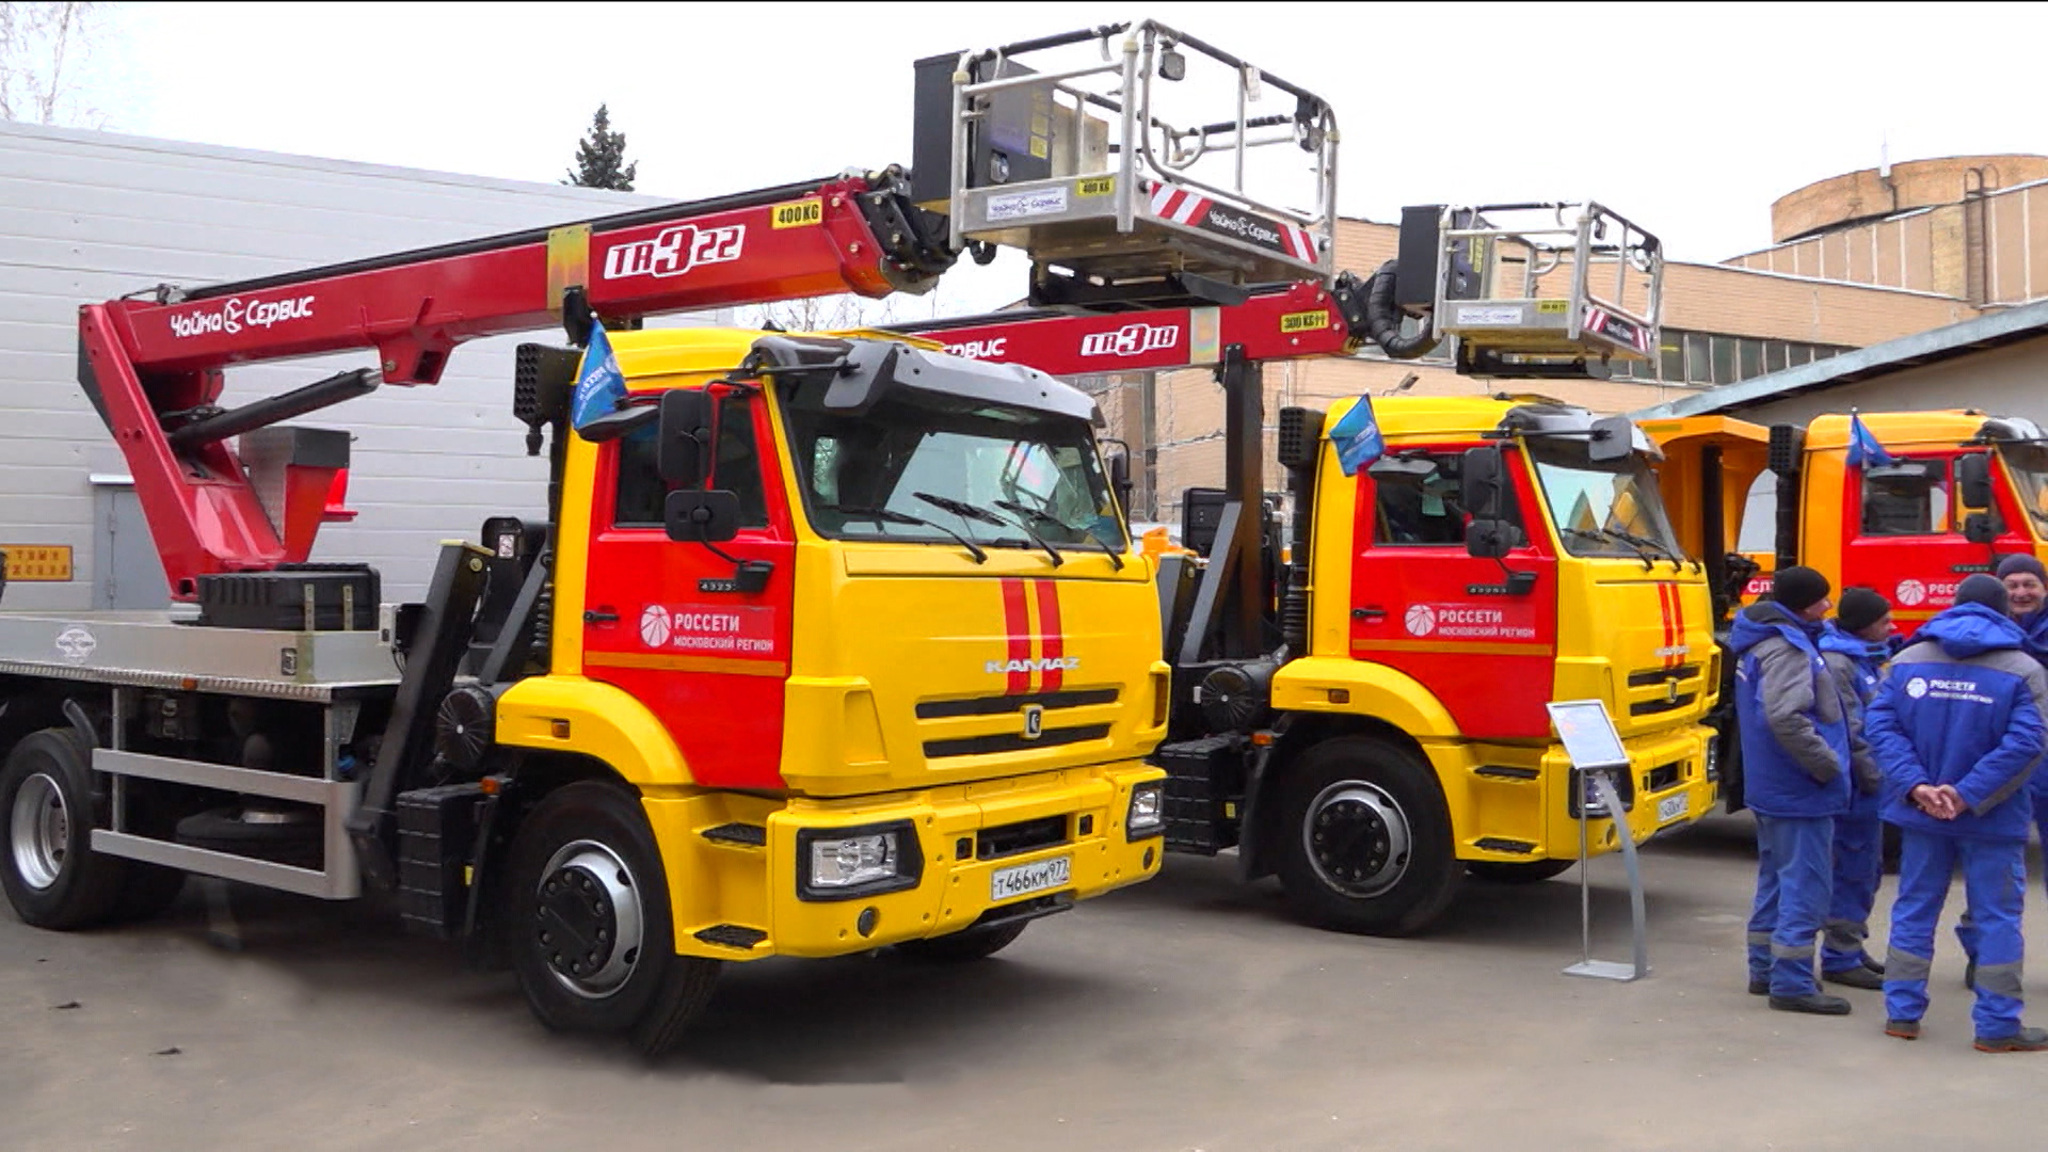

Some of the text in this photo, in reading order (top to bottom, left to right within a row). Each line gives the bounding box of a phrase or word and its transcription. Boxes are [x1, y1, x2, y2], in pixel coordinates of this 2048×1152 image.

[674, 613, 740, 632] РОССЕТИ
[1439, 610, 1502, 623] РОССЕТИ
[1500, 627, 1536, 639] РЕГИОН
[674, 635, 774, 652] МОСКОВСКИЙ РЕГИОН
[985, 657, 1080, 673] KAMAZ
